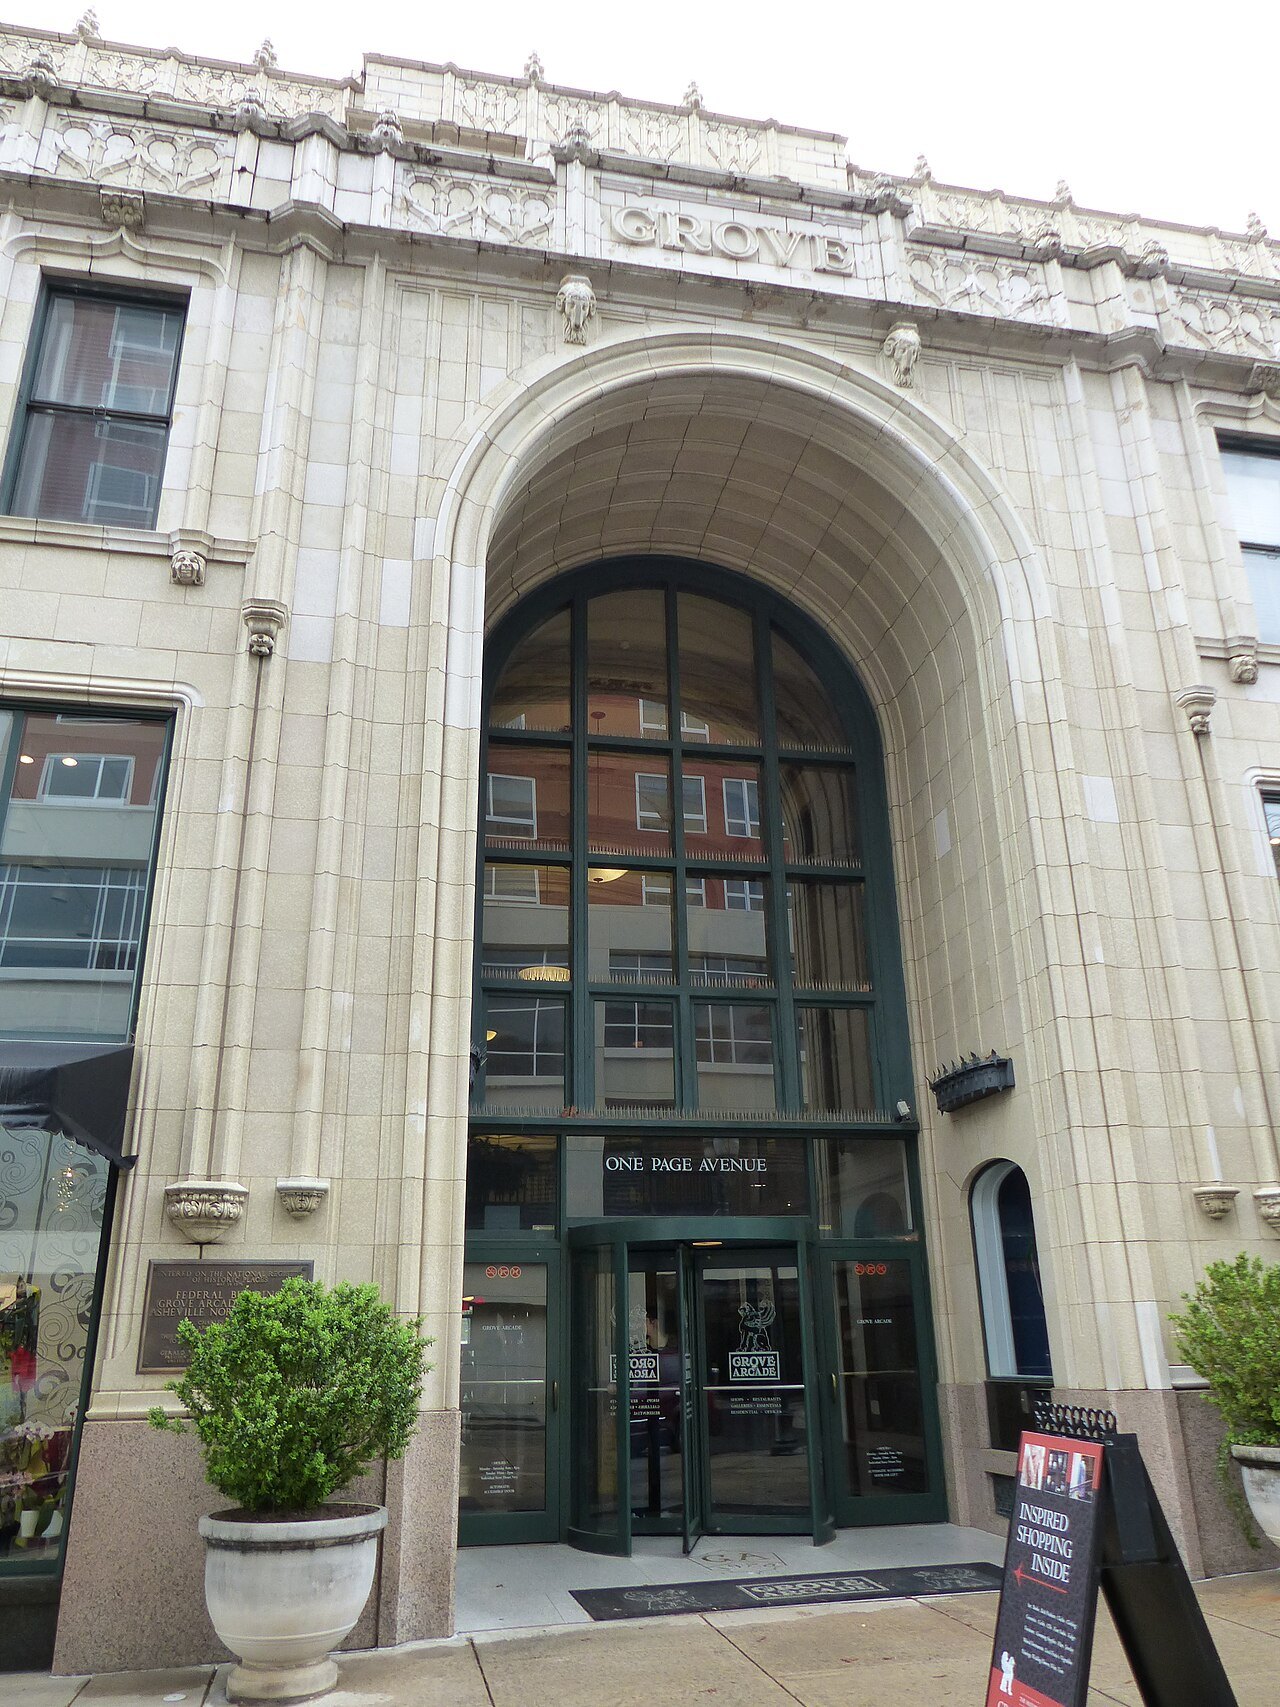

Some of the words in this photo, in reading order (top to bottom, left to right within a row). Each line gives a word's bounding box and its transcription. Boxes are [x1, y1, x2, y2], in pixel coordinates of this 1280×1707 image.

[613, 206, 855, 277] GROVE
[605, 1157, 644, 1171] ONE
[651, 1157, 693, 1172] PAGE
[698, 1158, 767, 1172] AVENUE
[176, 1290, 223, 1299] FEDERAL
[158, 1299, 194, 1308] GROVE
[198, 1299, 236, 1308] ARCAD
[732, 1356, 776, 1367] GROVE
[732, 1367, 777, 1377] ARCADE
[1019, 1502, 1070, 1532] INSPIRED
[1016, 1525, 1073, 1559] SHOPPING
[1030, 1552, 1070, 1583] INSIDE
